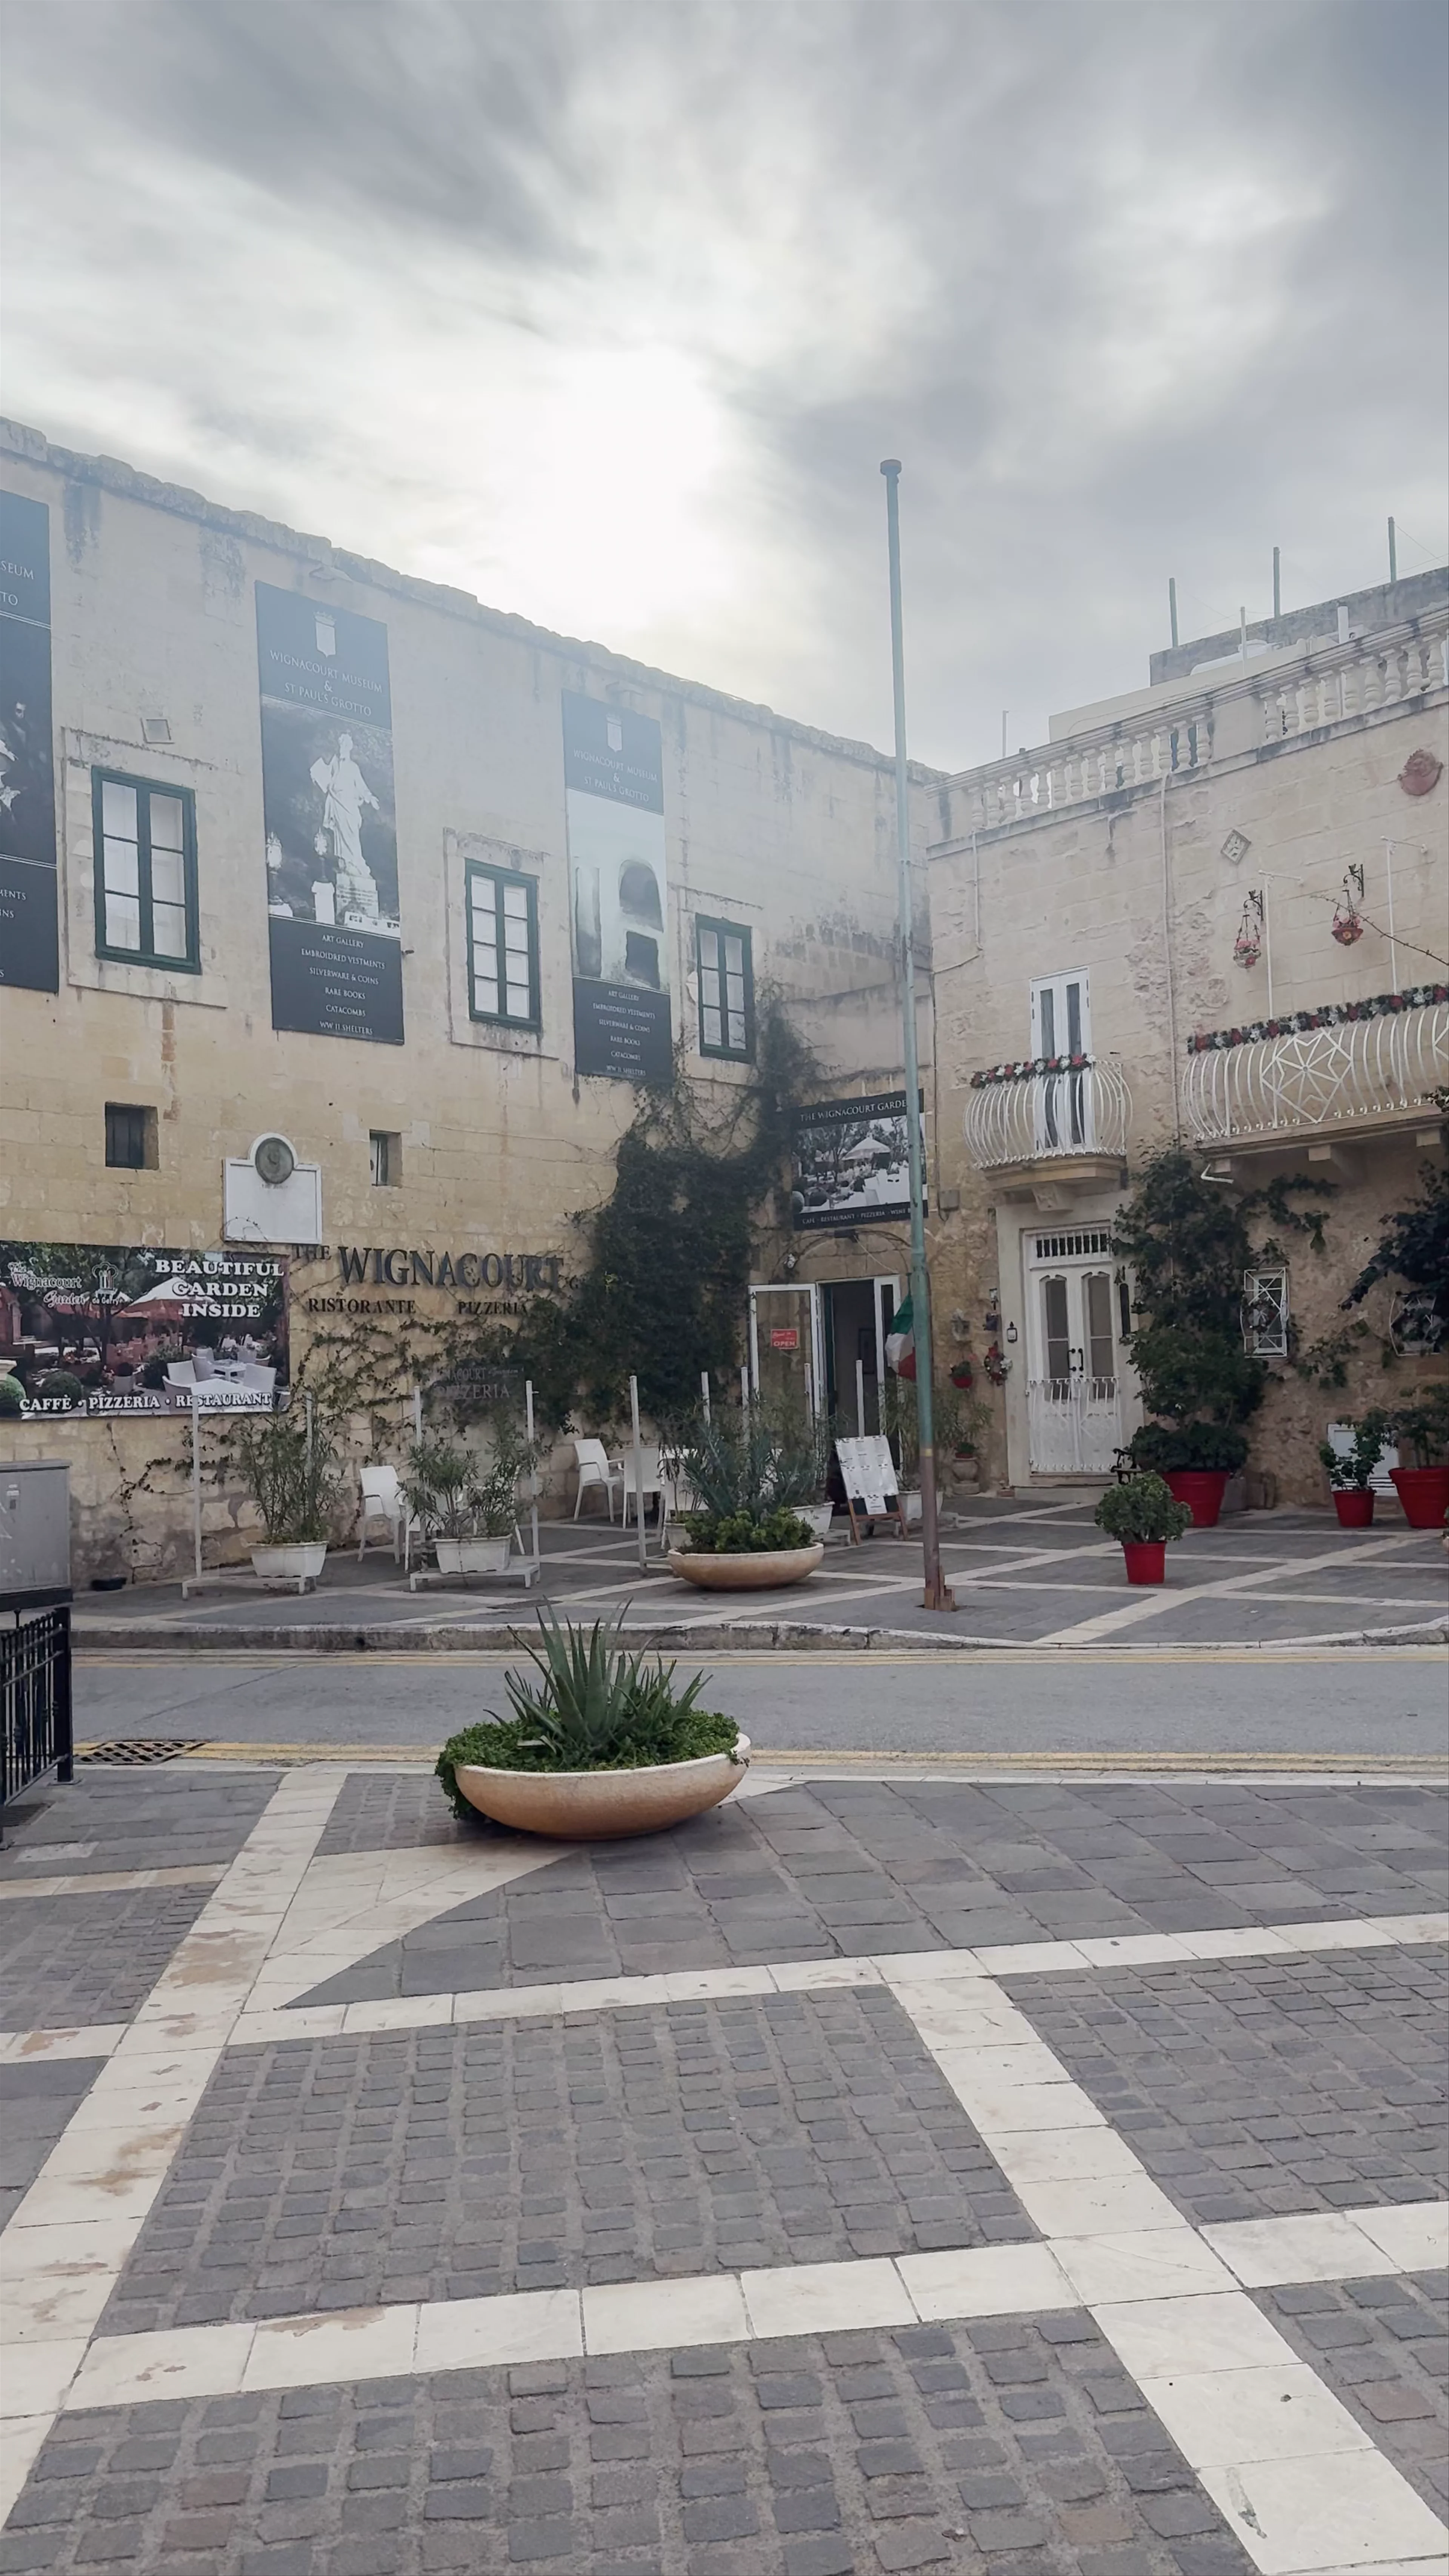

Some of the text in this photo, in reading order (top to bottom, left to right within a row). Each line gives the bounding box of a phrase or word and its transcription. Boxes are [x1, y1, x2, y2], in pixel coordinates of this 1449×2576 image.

[270, 650, 382, 693] WIGNACOURT MUSEUM
[324, 680, 332, 692] &
[285, 682, 371, 717] ST PAUL'S GROTTO
[574, 749, 658, 783] WIGNACOURT MUSEUM
[613, 772, 620, 783] &
[619, 786, 649, 802] GROTTO
[322, 934, 365, 948] ART GALLERY
[301, 948, 385, 969] EMBROIDRED VESTMENTS
[309, 967, 349, 980] SILVERWARE
[358, 975, 379, 985] COINS
[325, 987, 366, 1000] RARE BOOKS
[618, 992, 640, 1001] GALLERY
[326, 1004, 366, 1017] CATACOMBS
[343, 1024, 373, 1035] SHELTERS
[598, 1018, 628, 1029] SILVERWARE
[634, 1024, 651, 1033] COINS
[624, 1037, 641, 1046] BOOKS
[611, 1050, 641, 1061] CATACOMBS
[623, 1067, 646, 1076] SHELTERS
[800, 1100, 906, 1121] THE WIGNACOURT GARDE
[821, 1213, 855, 1222] RESTAURANT
[860, 1210, 886, 1218] PIZZERIA
[155, 1259, 284, 1276] BEAUTIFUL
[292, 1245, 331, 1260] THE
[338, 1246, 564, 1291] WIGNACOURT
[11, 1273, 83, 1290] Wignacourt
[172, 1282, 269, 1296] GARDEN
[182, 1304, 261, 1317] INSIDE
[308, 1298, 528, 1315] RISTORANTE PIZZERIA
[19, 1395, 72, 1411] CAFFÈ
[89, 1396, 160, 1409] PIZZERIA
